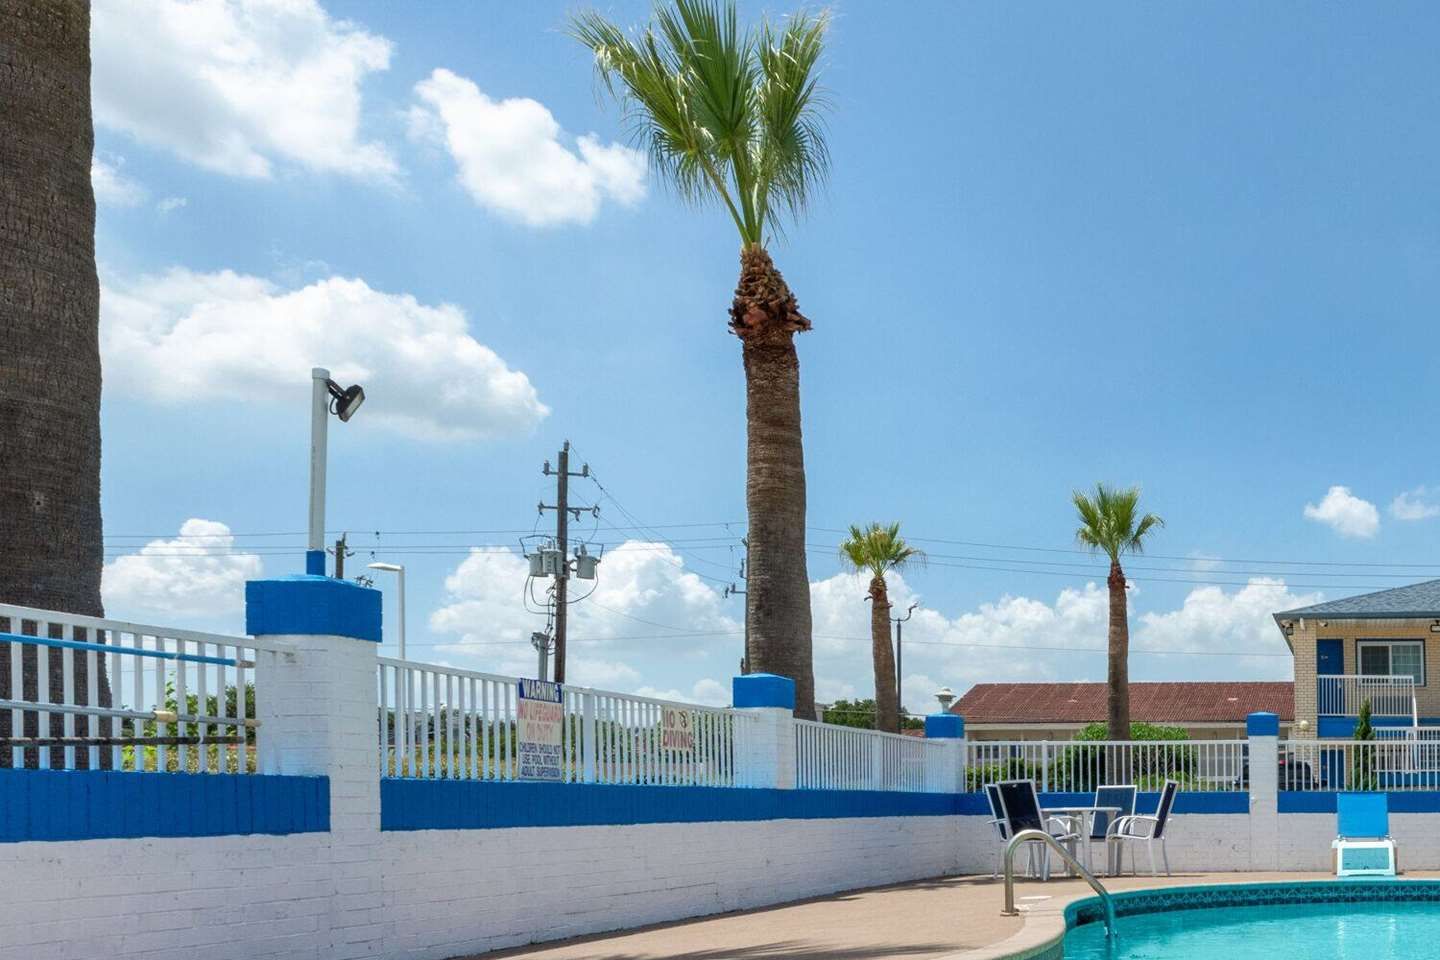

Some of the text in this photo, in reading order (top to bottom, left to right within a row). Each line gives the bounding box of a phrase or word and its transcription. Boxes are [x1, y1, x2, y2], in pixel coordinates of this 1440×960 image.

[523, 680, 560, 702] WARNING
[662, 710, 675, 728] NO
[662, 730, 693, 748] DIVING
